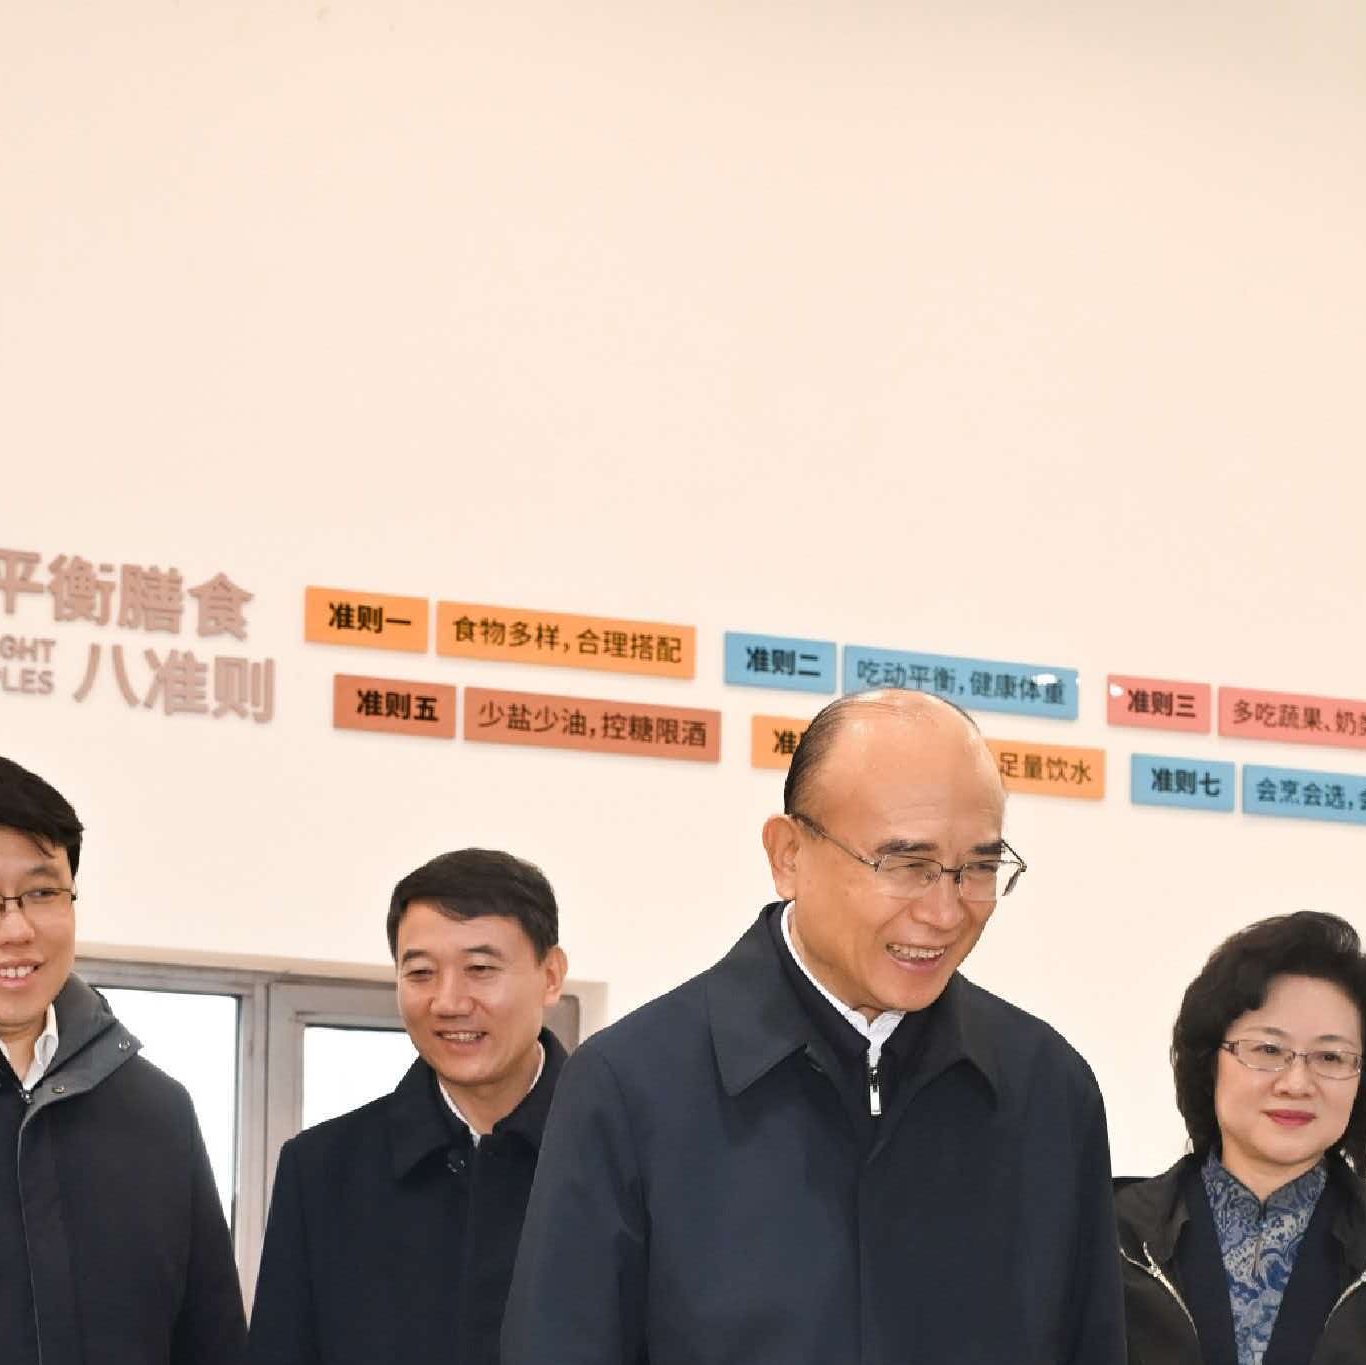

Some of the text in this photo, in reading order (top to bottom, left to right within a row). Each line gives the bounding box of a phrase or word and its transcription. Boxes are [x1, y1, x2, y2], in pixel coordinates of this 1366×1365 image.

[327, 602, 683, 665] 准则一 食物多样，合理搭配
[745, 645, 822, 679] 准则二
[72, 642, 276, 724] 八准则
[355, 688, 440, 723] 准则五
[1127, 688, 1196, 719] 准则三
[1151, 767, 1222, 798] 准则七
